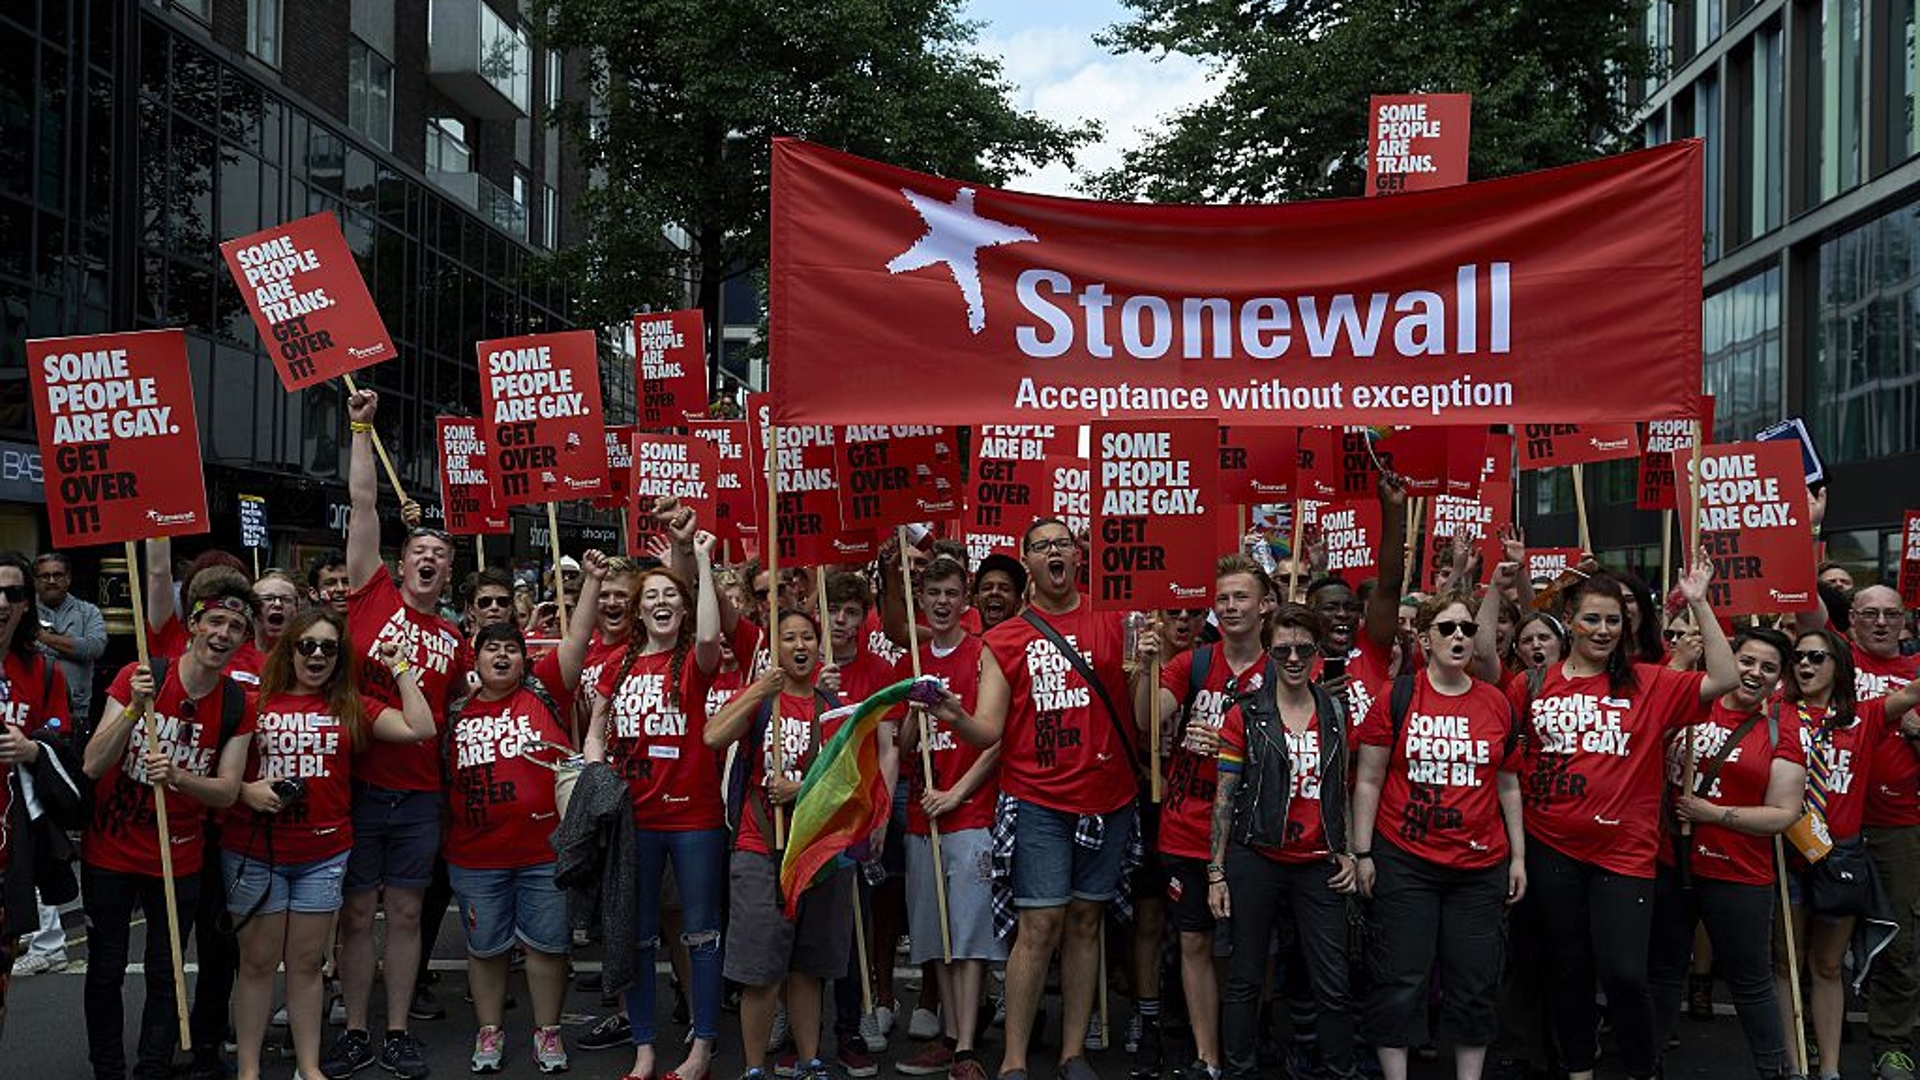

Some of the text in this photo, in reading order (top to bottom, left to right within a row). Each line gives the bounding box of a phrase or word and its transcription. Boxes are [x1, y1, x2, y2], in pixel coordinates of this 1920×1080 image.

[1378, 104, 1427, 122] SOME
[1378, 121, 1441, 139] PEOPLE
[1376, 139, 1410, 156] ARE
[1376, 155, 1437, 173] TRANS.
[1376, 174, 1406, 190] GET
[236, 236, 297, 269] SOME
[245, 250, 321, 287] PEOPLE
[255, 278, 297, 306] ARE
[261, 288, 335, 325] TRANS.
[1015, 262, 1511, 358] Stonewall
[271, 317, 310, 343] GET
[640, 320, 674, 336] SOME
[280, 331, 335, 361] OVER
[641, 333, 684, 351] PEOPLE
[44, 349, 129, 383] SOME
[489, 346, 552, 375] SOME
[642, 350, 664, 364] ARE
[288, 357, 317, 382] IT!
[643, 362, 685, 379] TRANS.
[48, 378, 157, 413] PEOPLE
[491, 369, 573, 399] PEOPLE
[1014, 375, 1513, 416] Acceptance without exception
[495, 392, 590, 424] ARE GAY.
[53, 407, 180, 445] ARE GAY.
[444, 425, 476, 440] SOME
[497, 421, 537, 446] GET
[845, 425, 889, 443] ARE
[1649, 420, 1695, 435] PEOPL
[445, 440, 486, 455] PEOPLE
[641, 442, 687, 461] SOME
[848, 443, 889, 468] GET
[979, 437, 1046, 460] ARE BI.
[1102, 433, 1170, 459] SOME
[1528, 438, 1553, 460] IT!
[1646, 436, 1674, 452] ARE
[56, 444, 110, 474] GET
[446, 455, 469, 470] ARE
[499, 446, 557, 471] OVER
[640, 460, 700, 479] PEOPLE
[447, 470, 488, 485] TRANS.
[850, 466, 912, 494] OVER
[980, 460, 1017, 482] GET
[1102, 461, 1189, 487] PEOPLE
[60, 472, 138, 503] OVER
[502, 472, 529, 496] IT!
[639, 478, 708, 499] ARE GAY.
[978, 482, 1030, 505] OVER
[450, 498, 480, 512] OVER
[853, 495, 882, 520] IT!
[1053, 491, 1090, 515] PEO
[1101, 489, 1205, 516] ARE GAY.
[1435, 504, 1493, 523] PEOPLE
[64, 507, 101, 535] IT!
[977, 505, 1002, 526] IT!
[1321, 510, 1355, 529] SOME
[1744, 503, 1797, 527] GAY.
[1102, 519, 1147, 543] GET
[1102, 546, 1166, 572] OVER
[1344, 547, 1374, 568] GAY.
[1530, 555, 1566, 569] SOME
[1102, 574, 1132, 599] IT!
[1033, 672, 1066, 692] ARE
[1033, 687, 1090, 711] TRANS
[1531, 693, 1598, 715] SOME
[1407, 712, 1469, 739] SOME
[1532, 710, 1620, 735] PEOPLE
[257, 732, 339, 755] PEOPLE
[457, 741, 496, 769] ARE
[1406, 735, 1490, 763] PEOPLE
[1582, 731, 1631, 757] GAY.
[258, 755, 330, 778] ARE BI.
[1407, 759, 1482, 786] ARE BI.
